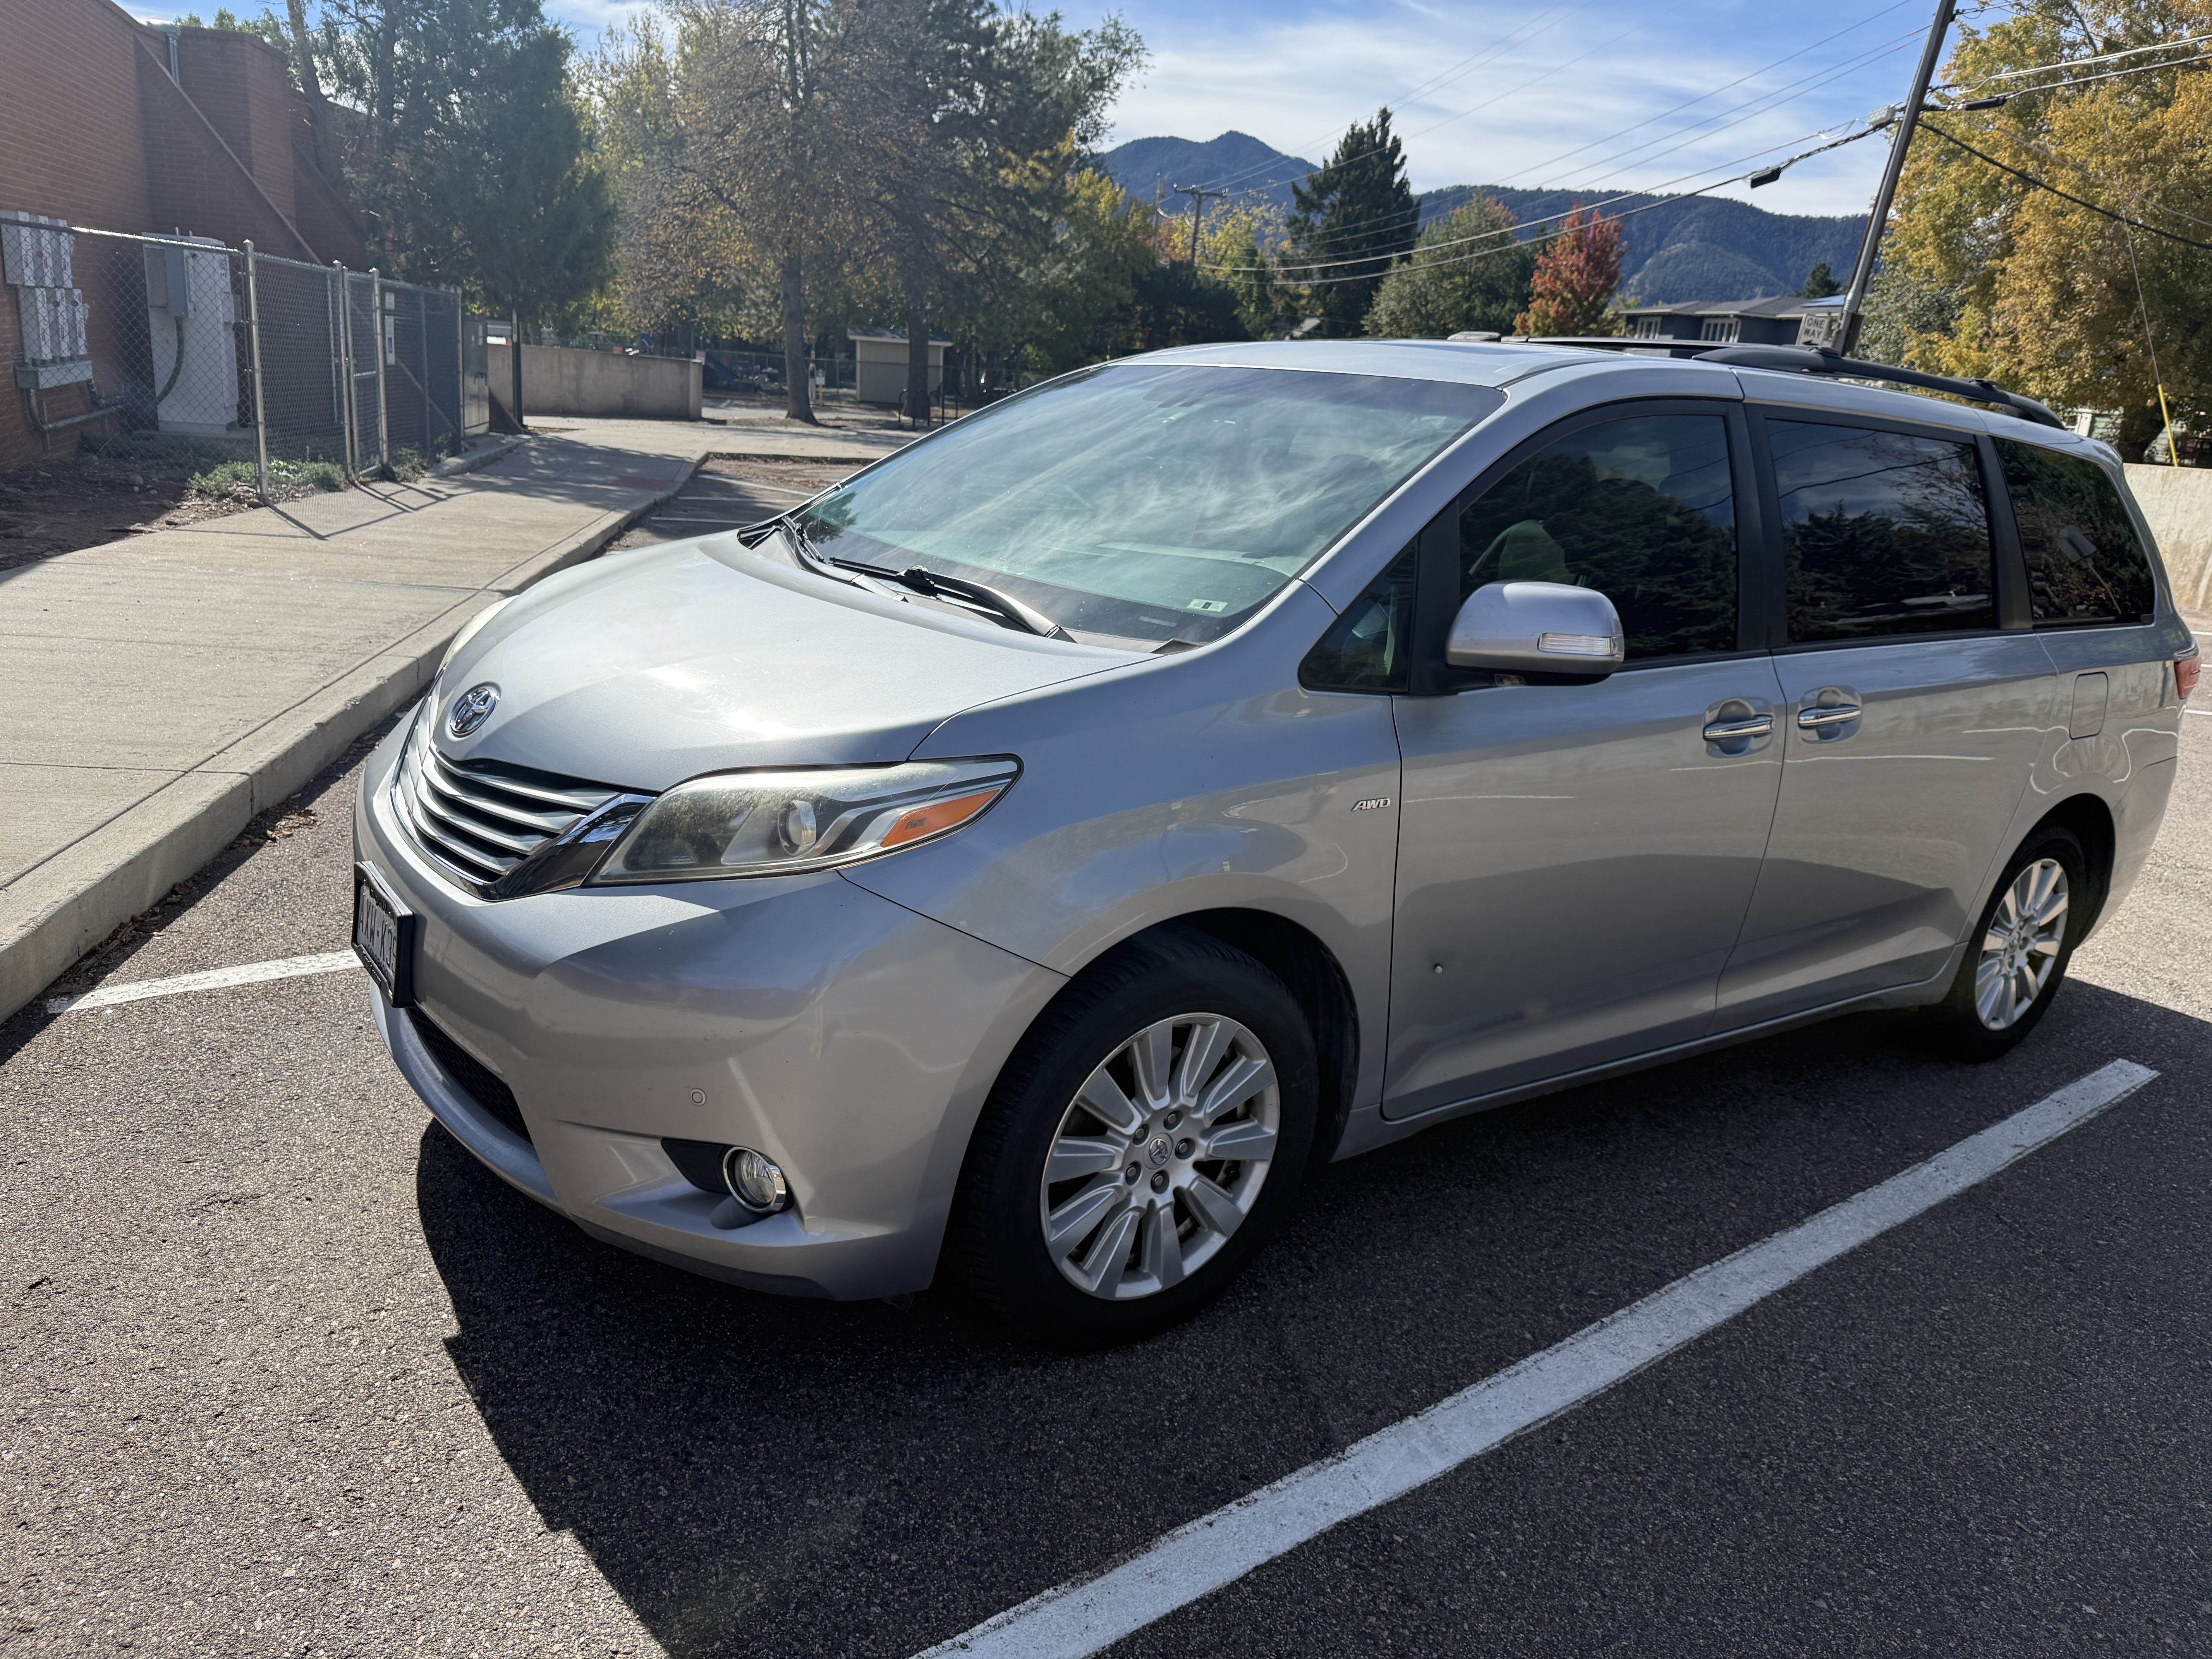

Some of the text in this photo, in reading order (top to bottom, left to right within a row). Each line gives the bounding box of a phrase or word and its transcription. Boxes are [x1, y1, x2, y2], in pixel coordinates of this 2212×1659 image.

[1807, 317, 1826, 329] ONE
[1803, 328, 1823, 339] WAY
[1351, 797, 1391, 812] AWD
